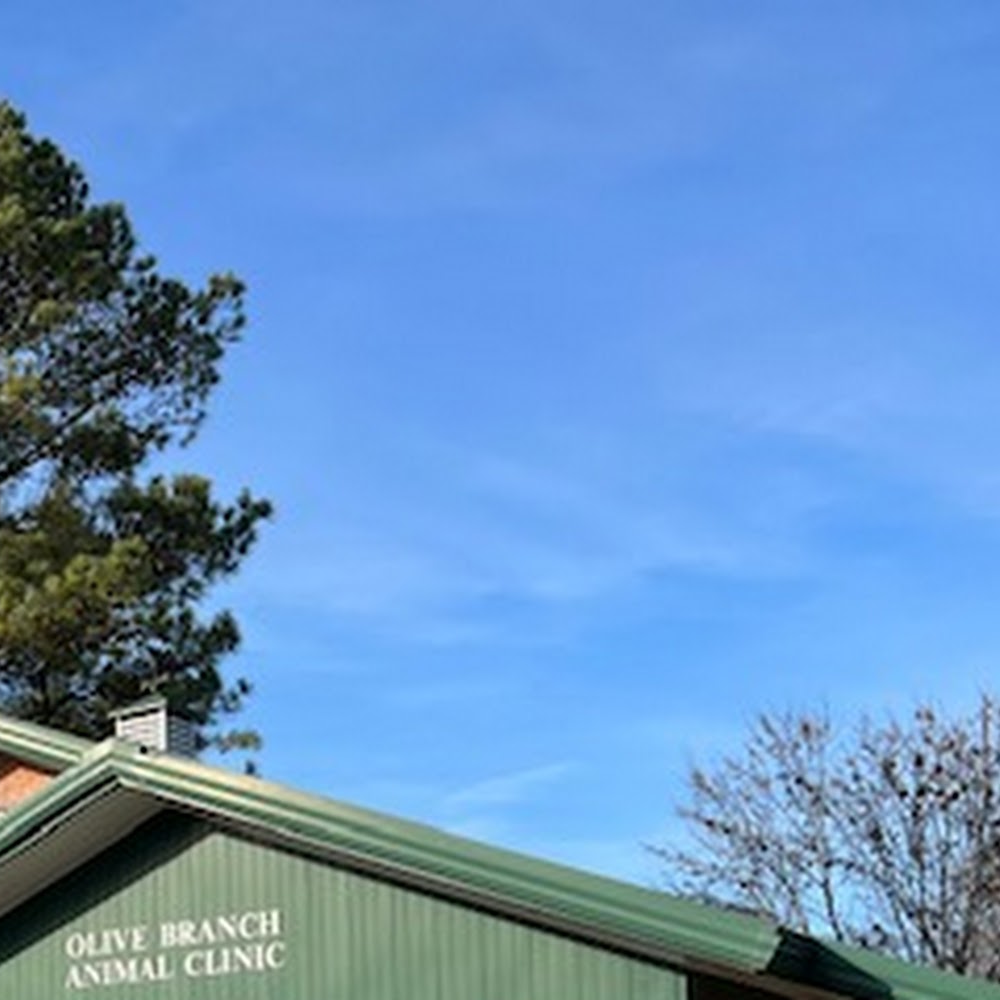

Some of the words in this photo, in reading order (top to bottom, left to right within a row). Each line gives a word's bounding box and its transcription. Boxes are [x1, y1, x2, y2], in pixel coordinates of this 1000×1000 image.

[66, 927, 146, 958] OLIVE
[161, 910, 280, 946] BRANCH
[66, 954, 173, 988] ANIMAL
[185, 943, 285, 976] CLINIC
